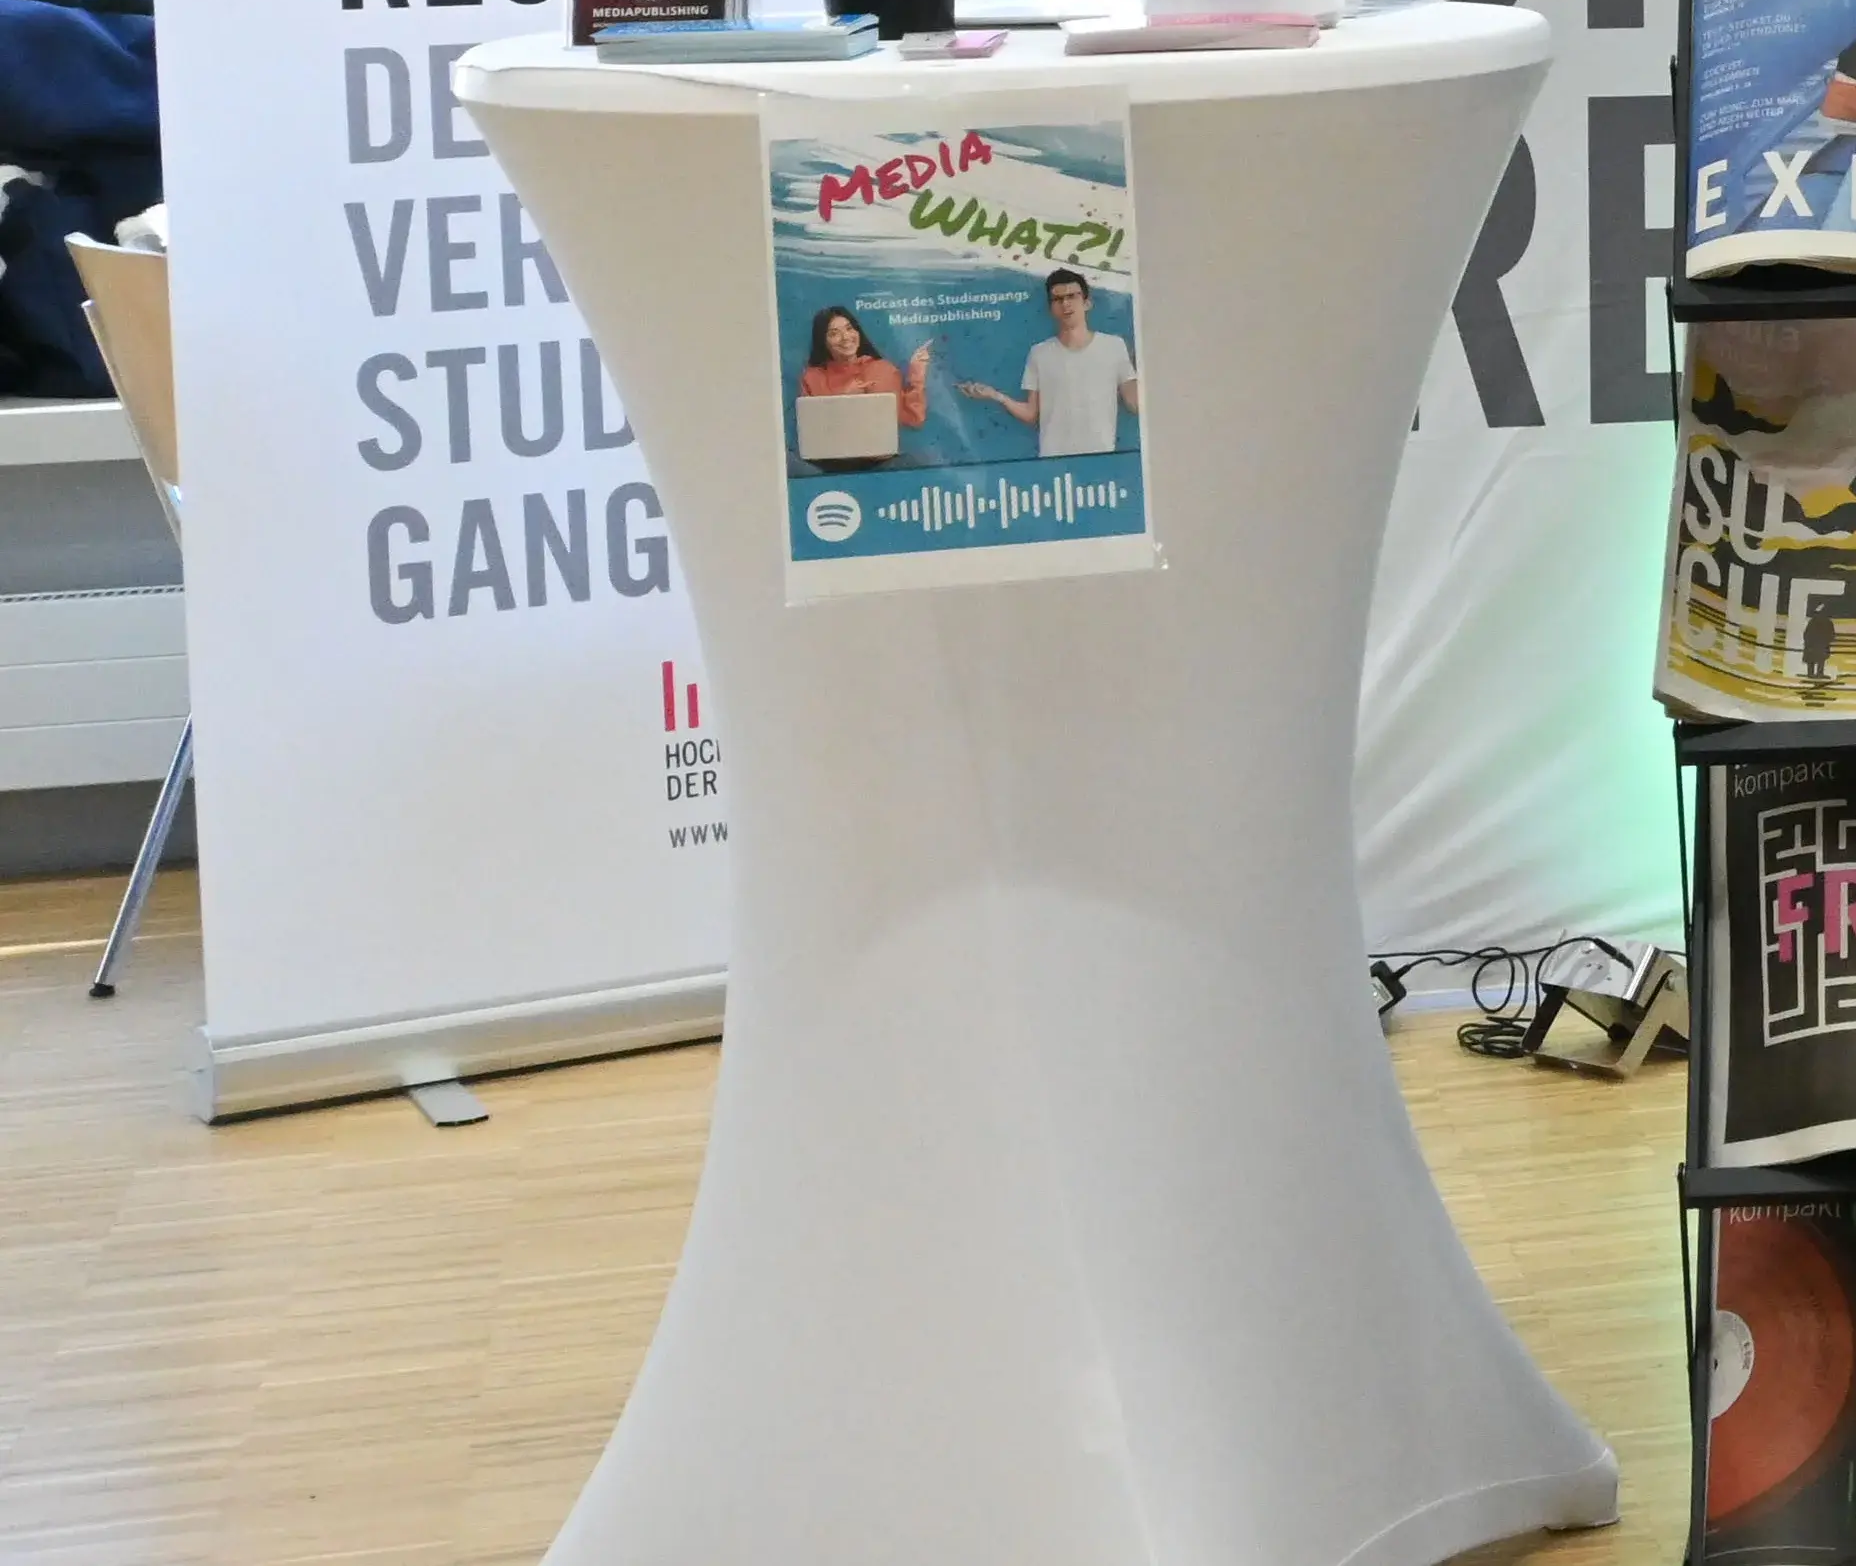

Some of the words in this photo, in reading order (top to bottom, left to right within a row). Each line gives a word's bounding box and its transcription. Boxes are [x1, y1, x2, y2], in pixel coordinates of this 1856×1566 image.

[592, 5, 709, 18] MEDIAPUBLISHING
[344, 45, 491, 164] DE
[818, 130, 994, 223] MEDIA
[908, 189, 1126, 272] WHAT?!
[855, 297, 907, 311] Podcast
[911, 297, 934, 307] des
[937, 290, 1030, 306] Studiengangs
[888, 308, 1002, 326] Mediapublishing
[665, 738, 721, 770] HOC
[667, 770, 718, 801] DER
[1734, 760, 1838, 799] kompakt
